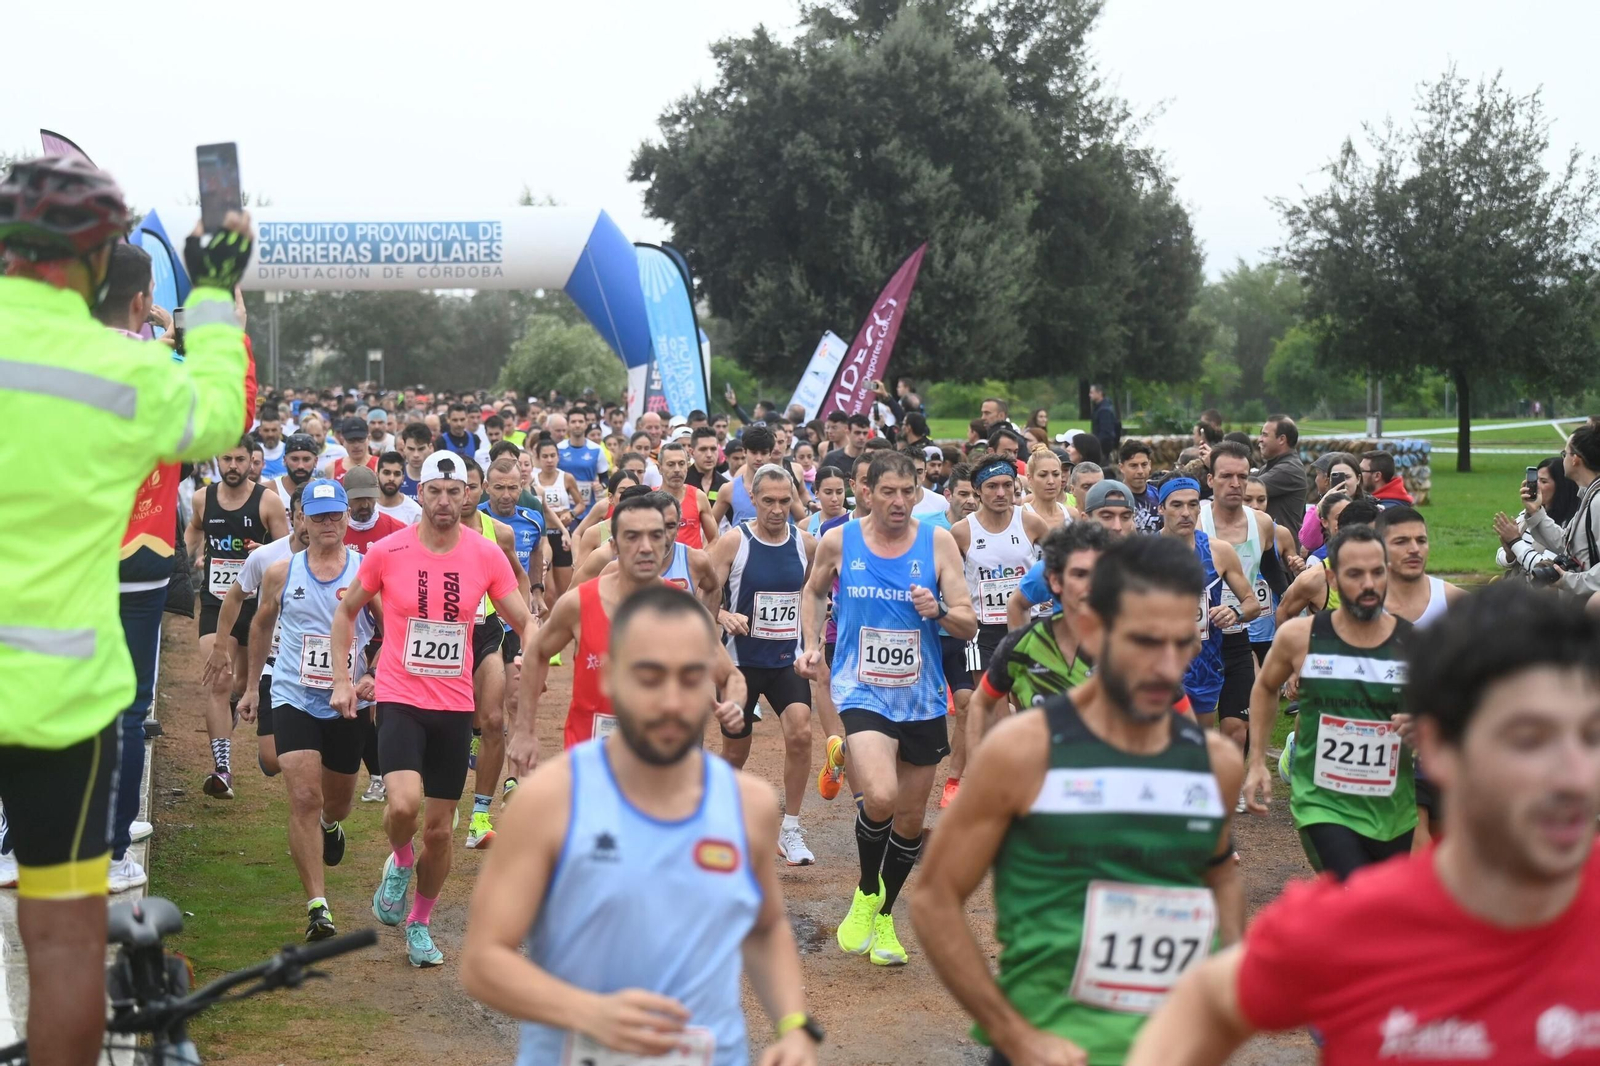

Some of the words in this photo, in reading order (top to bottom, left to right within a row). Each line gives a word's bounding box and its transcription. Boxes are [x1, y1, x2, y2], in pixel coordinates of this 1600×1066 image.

[258, 223, 348, 242] CIRCUITO
[355, 223, 472, 242] PROVINCIAL
[479, 223, 502, 241] DE
[258, 243, 372, 263] CARRERAS
[380, 242, 502, 263] POPULARES
[258, 264, 370, 279] DIPUTACIÓN
[383, 266, 404, 279] DE
[417, 263, 504, 279] CÓRDOBA
[978, 564, 1026, 580] indea
[418, 570, 428, 619] UNNERS
[443, 572, 461, 622] RDOBA
[847, 586, 914, 602] TROTASIER
[759, 606, 796, 622] 1176
[411, 640, 459, 660] 1201
[865, 645, 914, 666] 1096
[1321, 738, 1387, 767] 2211
[1096, 931, 1201, 974] 1197
